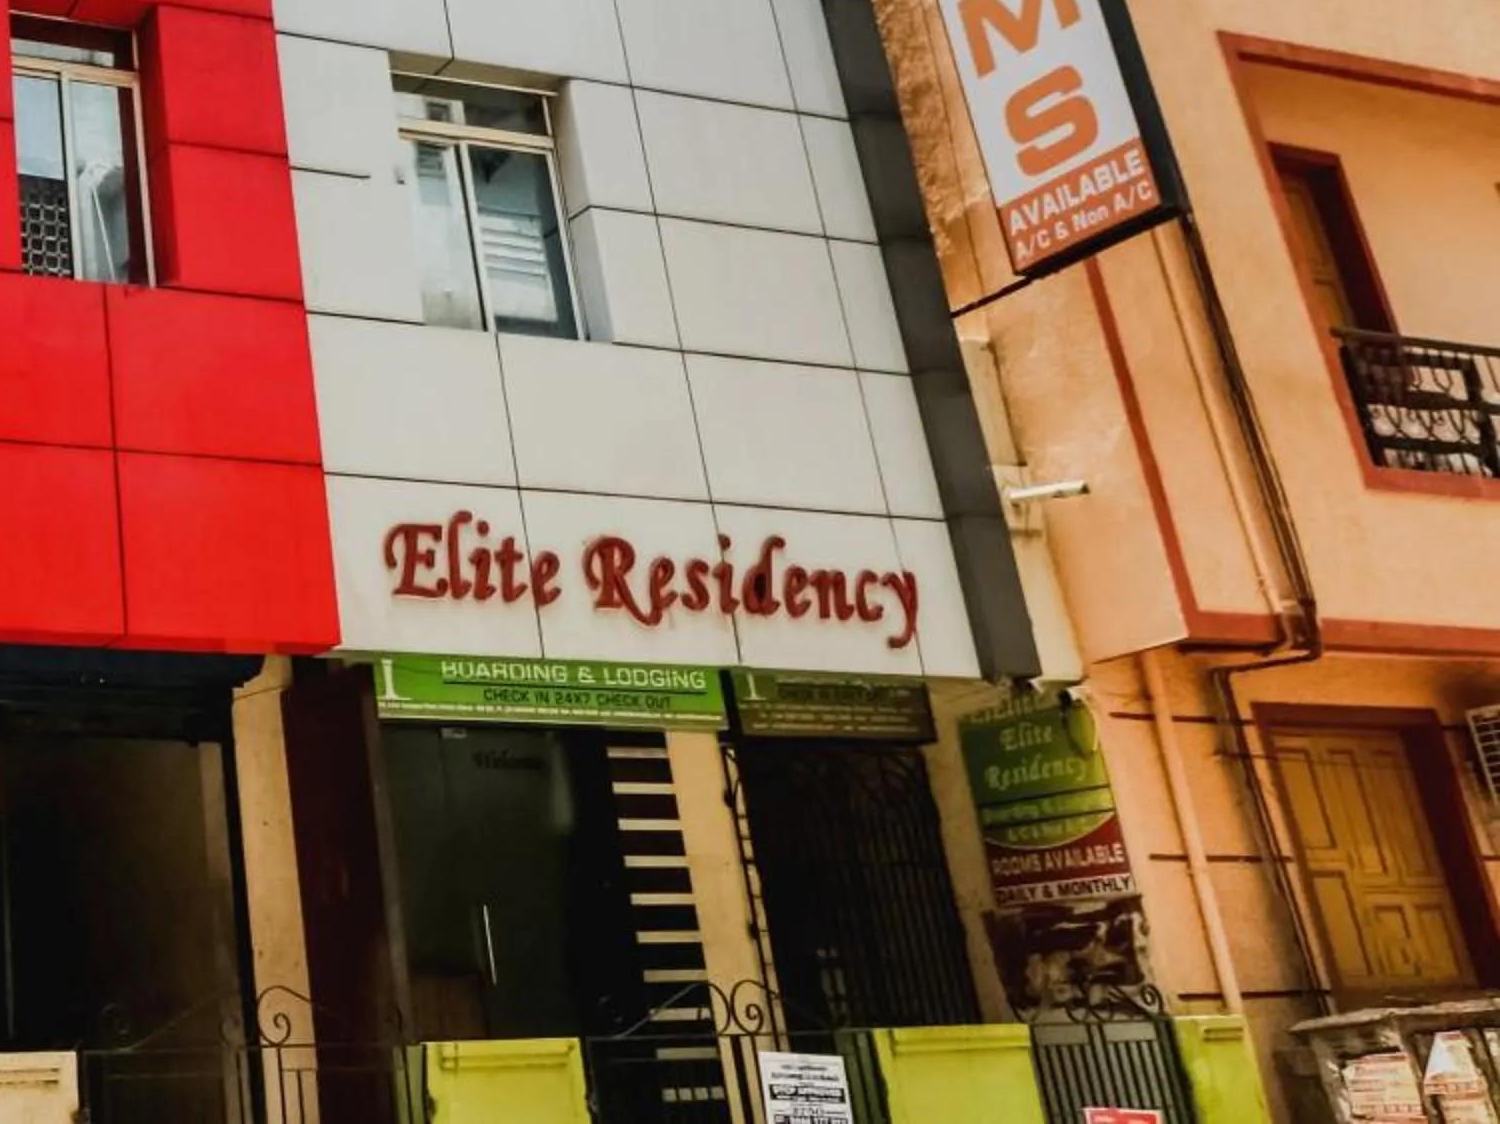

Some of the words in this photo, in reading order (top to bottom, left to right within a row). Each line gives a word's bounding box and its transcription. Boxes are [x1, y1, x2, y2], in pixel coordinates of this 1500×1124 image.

[1009, 148, 1145, 237] AVAILABLE
[1014, 229, 1050, 263] A/C
[1071, 203, 1109, 232] Non
[1113, 179, 1153, 214] A/C
[383, 509, 562, 606] Elite
[582, 533, 918, 650] Residency
[440, 660, 567, 684] BOARDING
[577, 668, 597, 684] &
[603, 666, 706, 690] LODGING
[483, 687, 530, 704] CHECK
[535, 690, 550, 705] IN
[596, 693, 640, 709] CHECK
[644, 695, 672, 710] OUT
[1000, 722, 1053, 752] Elite
[984, 754, 1086, 791] Residency
[992, 853, 1042, 876] ROOMS
[1044, 842, 1125, 871] AVAILABLE
[996, 886, 1037, 904] DAILY
[1043, 884, 1054, 898] &
[1057, 875, 1130, 896] MONTHLY
